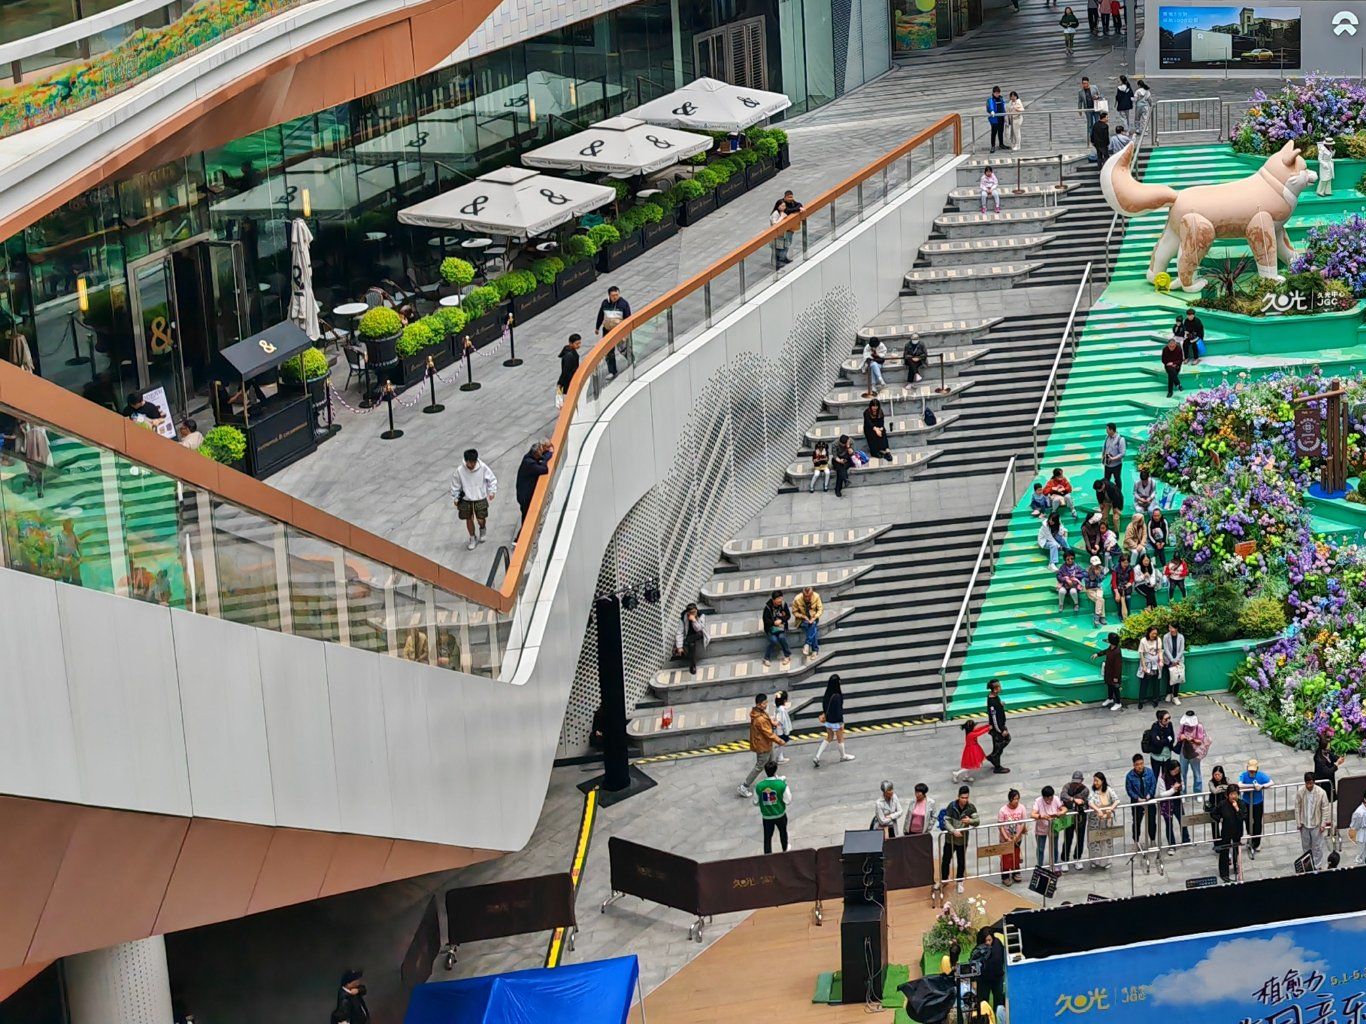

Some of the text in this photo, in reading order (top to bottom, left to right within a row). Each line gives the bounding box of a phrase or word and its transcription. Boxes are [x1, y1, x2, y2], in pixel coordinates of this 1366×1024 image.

[1316, 297, 1338, 308] JGC
[1252, 968, 1327, 1006] 植愈力
